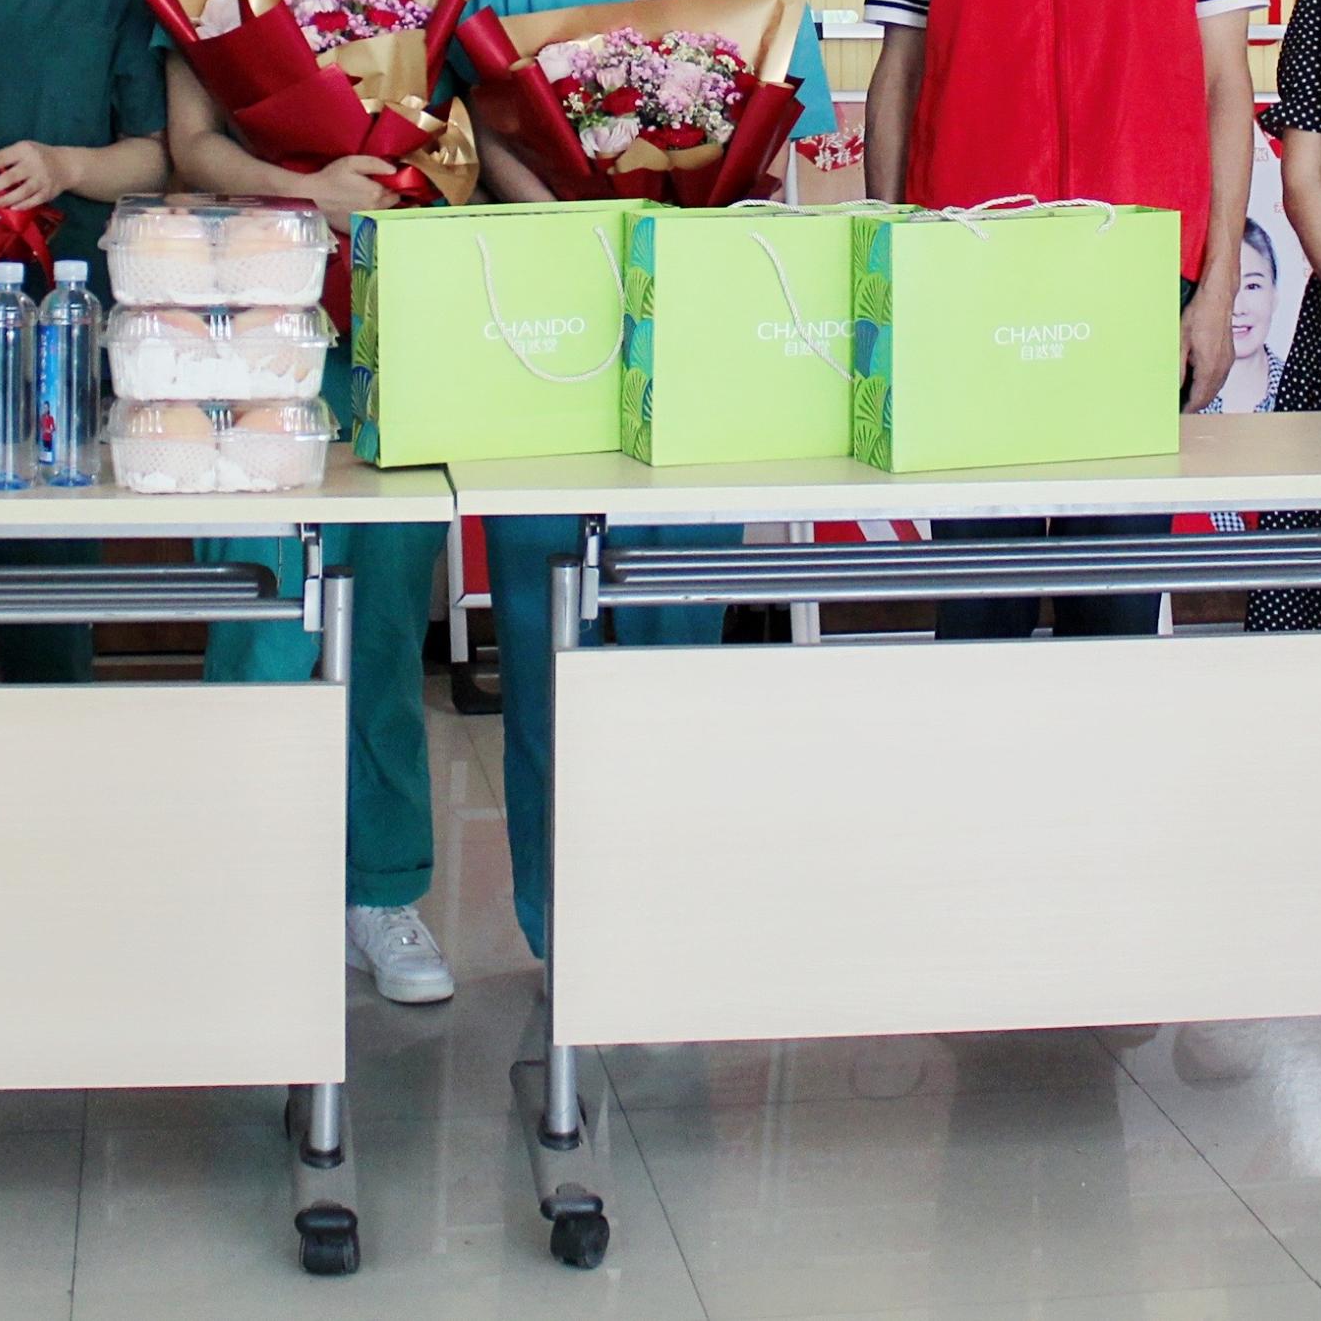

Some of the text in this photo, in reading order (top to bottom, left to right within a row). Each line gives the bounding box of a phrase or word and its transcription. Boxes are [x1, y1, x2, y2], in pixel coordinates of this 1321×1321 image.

[484, 317, 585, 340] CHANDO
[758, 320, 855, 340] CHANDO
[994, 322, 1091, 345] CHANDO
